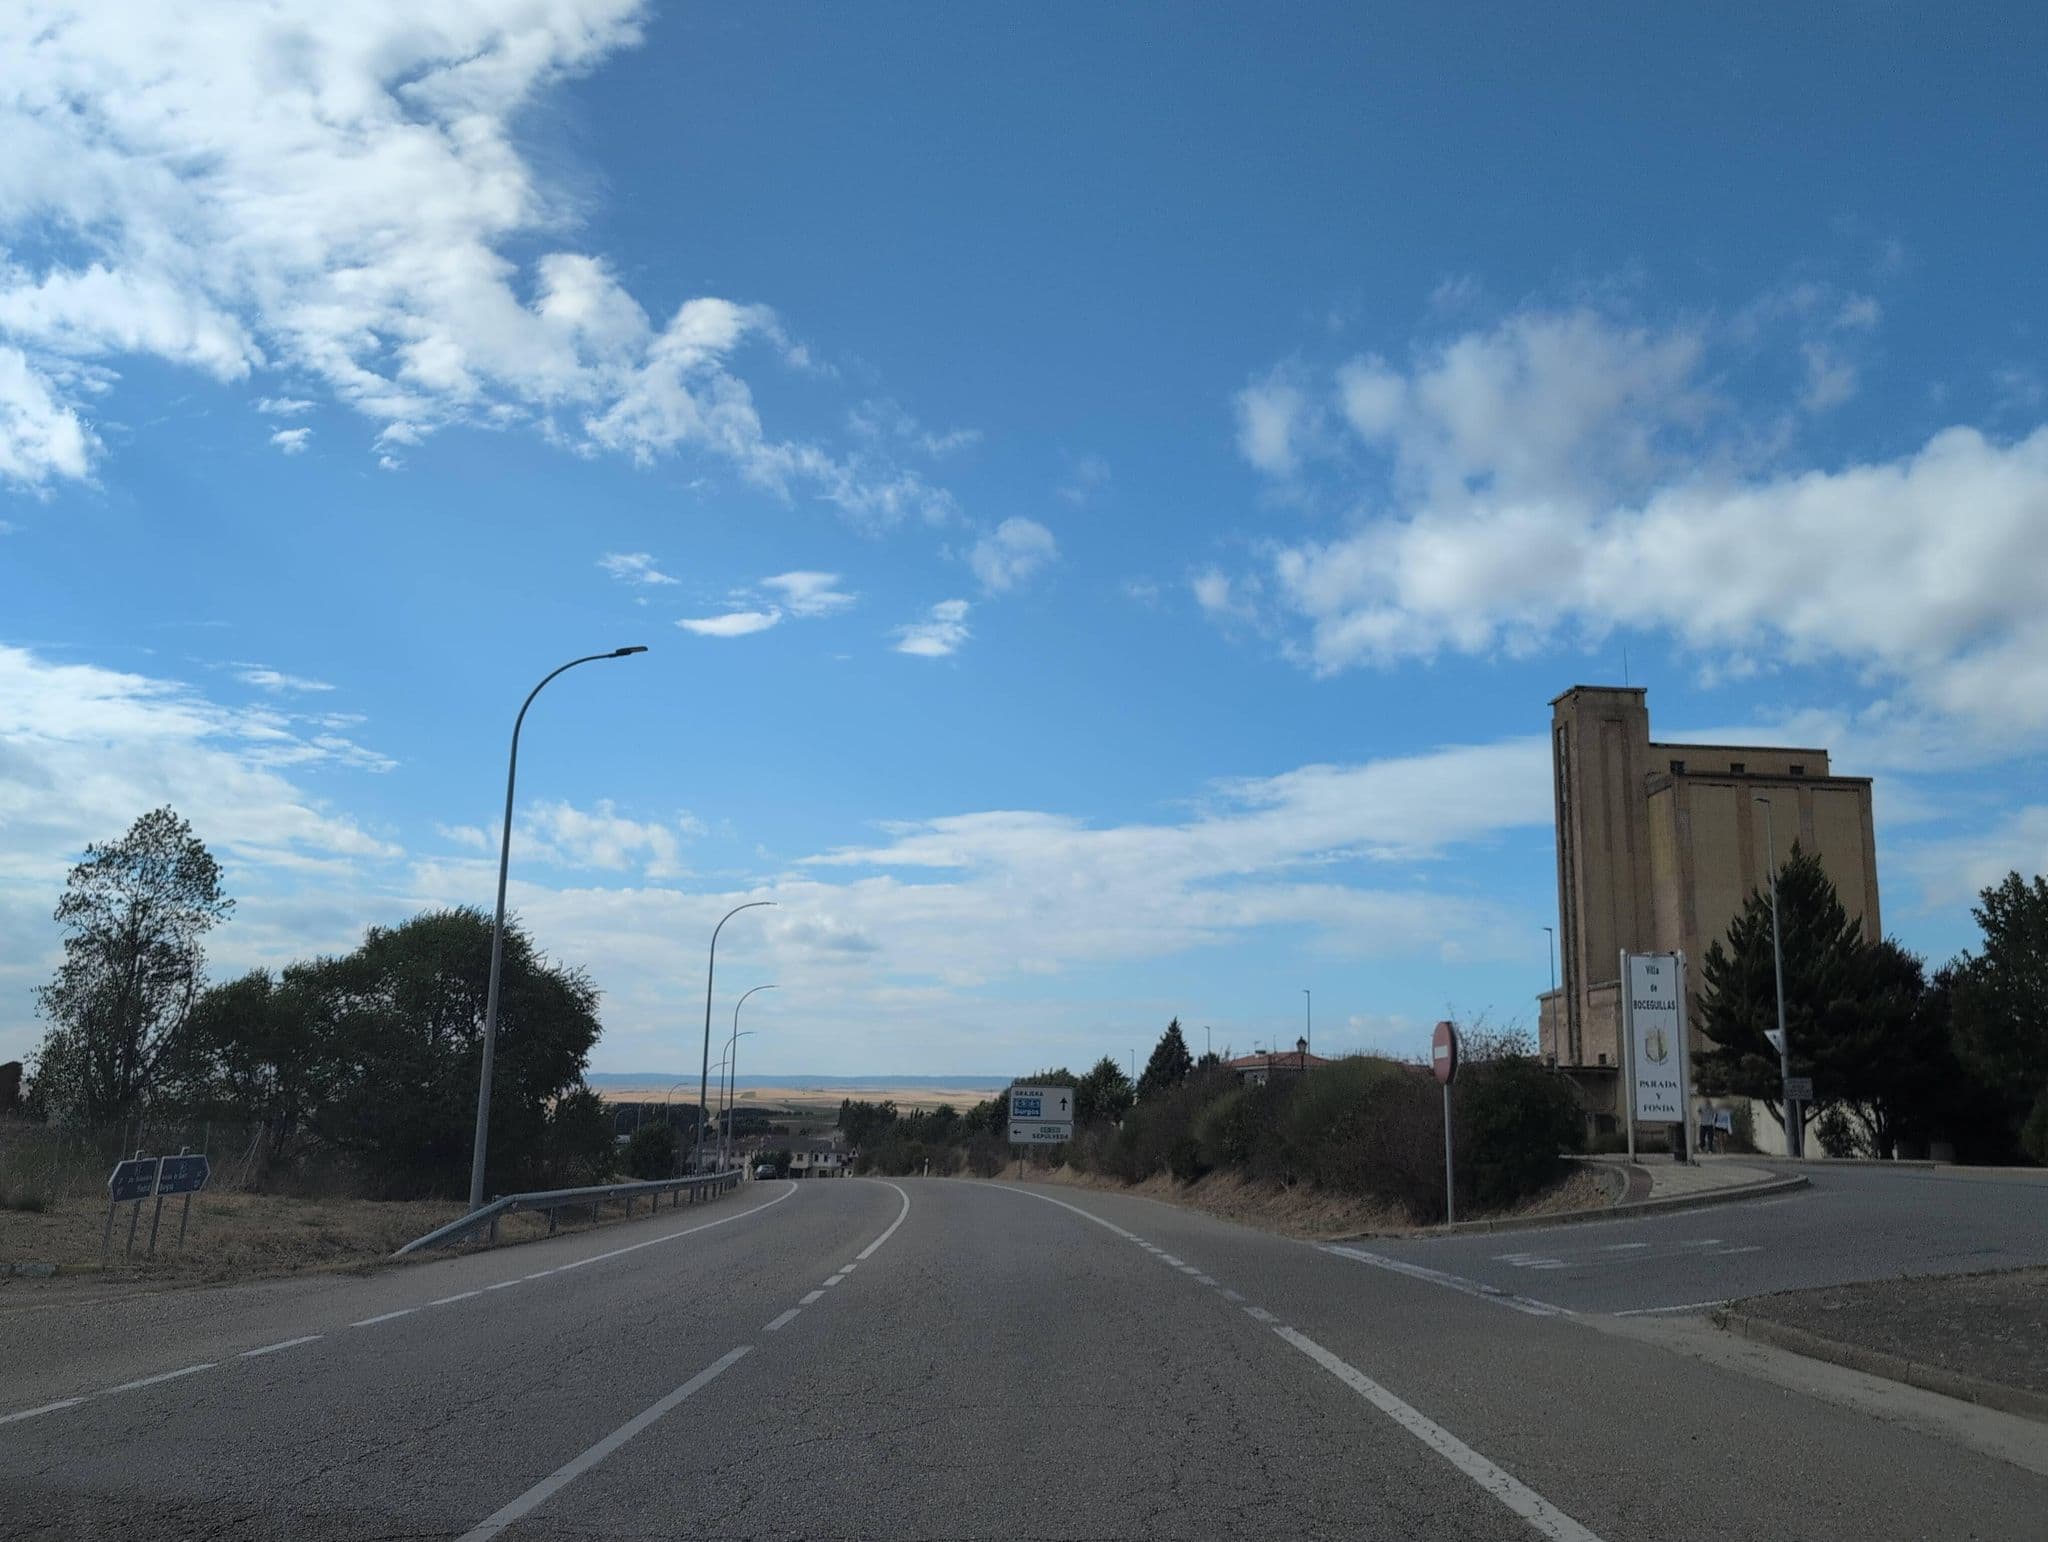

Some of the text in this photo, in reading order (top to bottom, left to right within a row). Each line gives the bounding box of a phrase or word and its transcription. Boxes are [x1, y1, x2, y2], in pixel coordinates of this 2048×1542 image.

[1645, 965, 1660, 976] Villa
[1650, 983, 1658, 993] de
[1633, 1000, 1676, 1011] BOCEGUILLAS
[1639, 1080, 1677, 1089] PARADA
[1655, 1092, 1662, 1100] Y
[1643, 1104, 1675, 1113] FONDA
